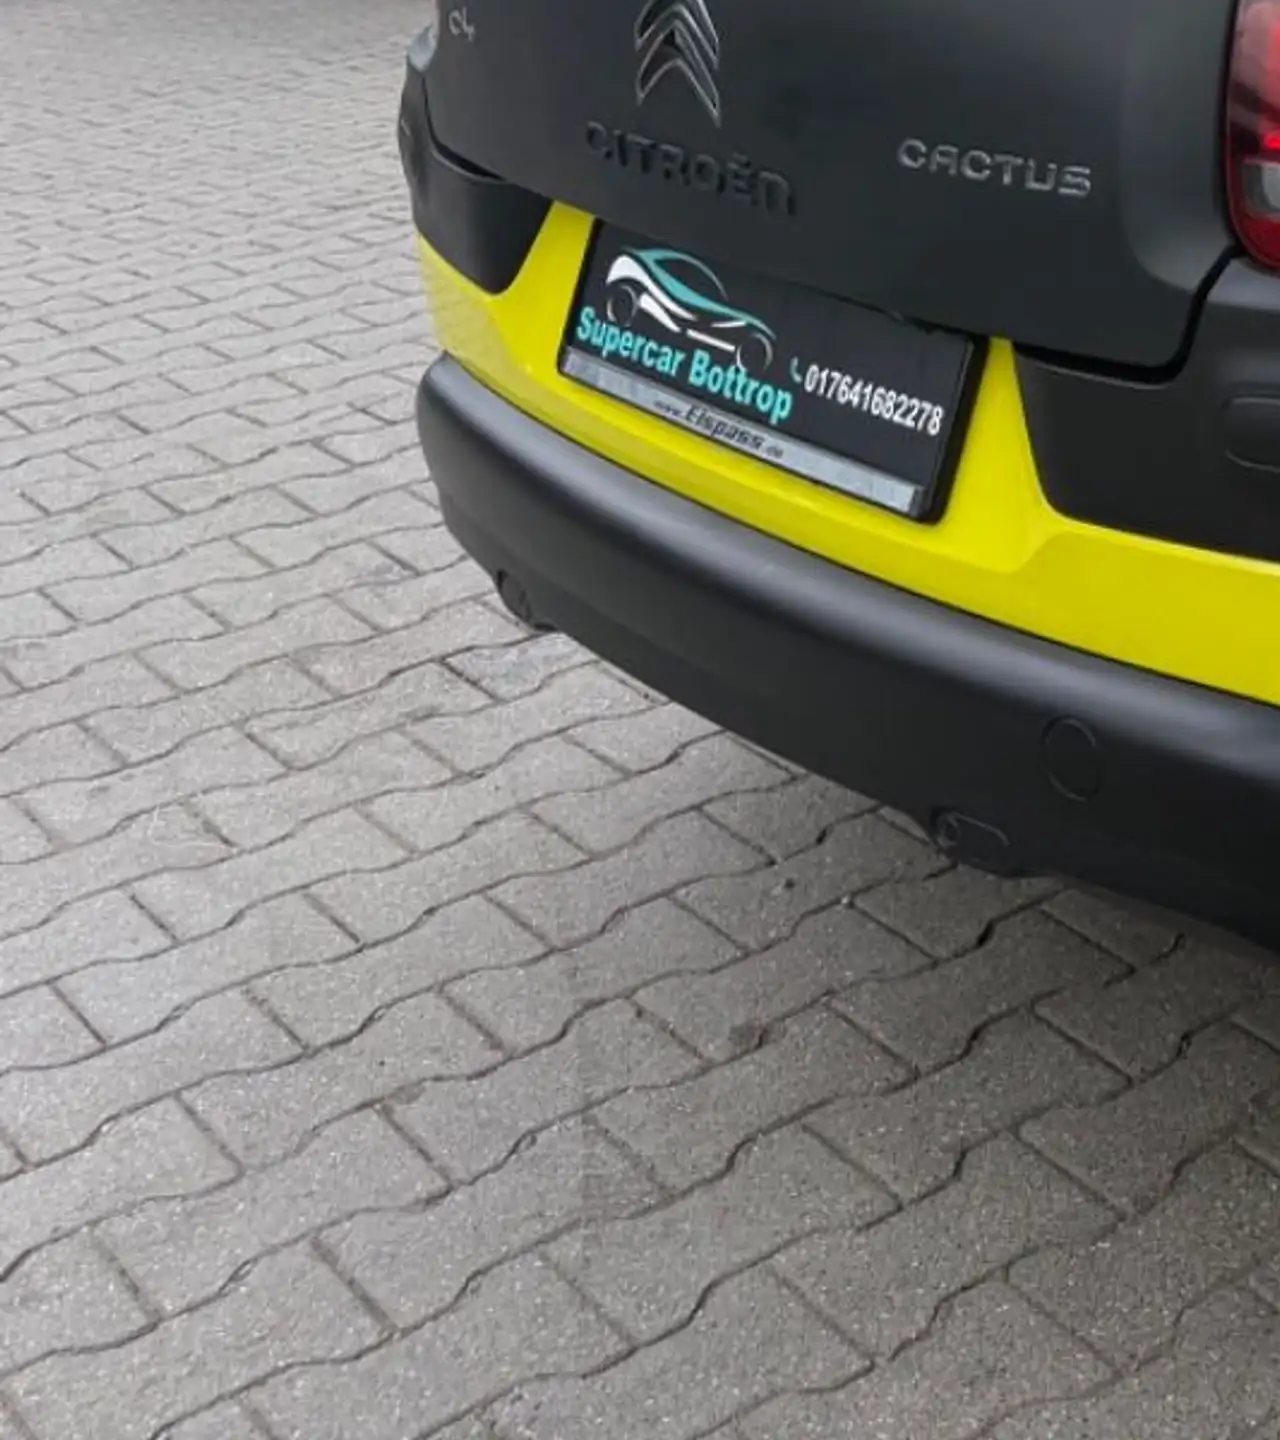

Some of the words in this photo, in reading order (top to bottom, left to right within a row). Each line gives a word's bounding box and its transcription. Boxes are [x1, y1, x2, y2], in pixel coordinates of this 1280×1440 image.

[448, 6, 476, 42] C4
[586, 120, 797, 217] CITROËN
[897, 137, 1092, 199] CACTUS
[576, 305, 686, 378] Supercar
[688, 348, 793, 426] Bottrop
[804, 363, 945, 436] 017641682278
